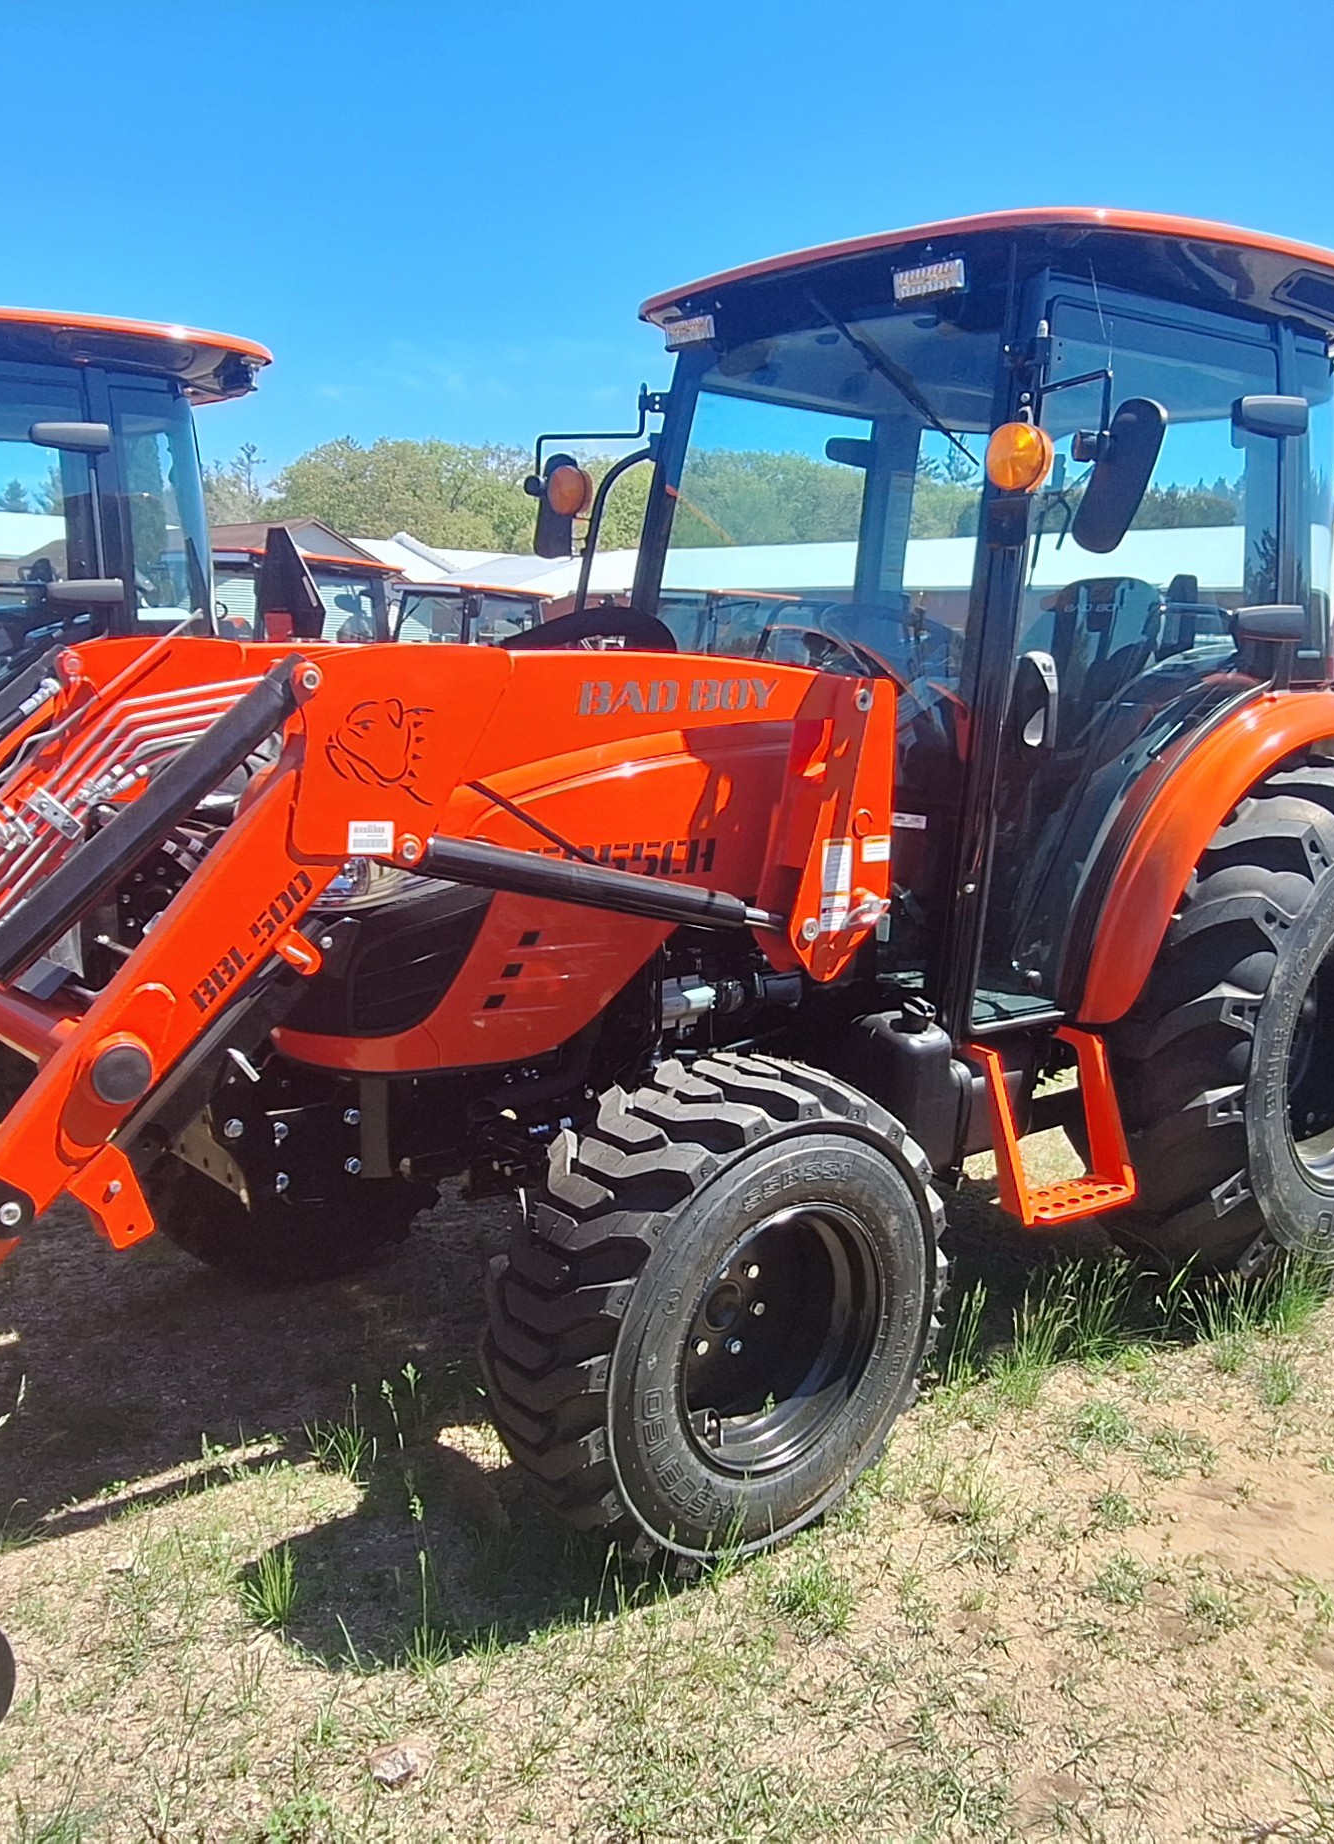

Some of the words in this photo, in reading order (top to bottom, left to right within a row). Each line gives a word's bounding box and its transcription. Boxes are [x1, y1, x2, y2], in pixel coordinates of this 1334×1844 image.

[576, 680, 680, 717] BAD
[688, 677, 780, 711] BOY
[189, 945, 255, 1014] BBL
[248, 870, 314, 947] 500
